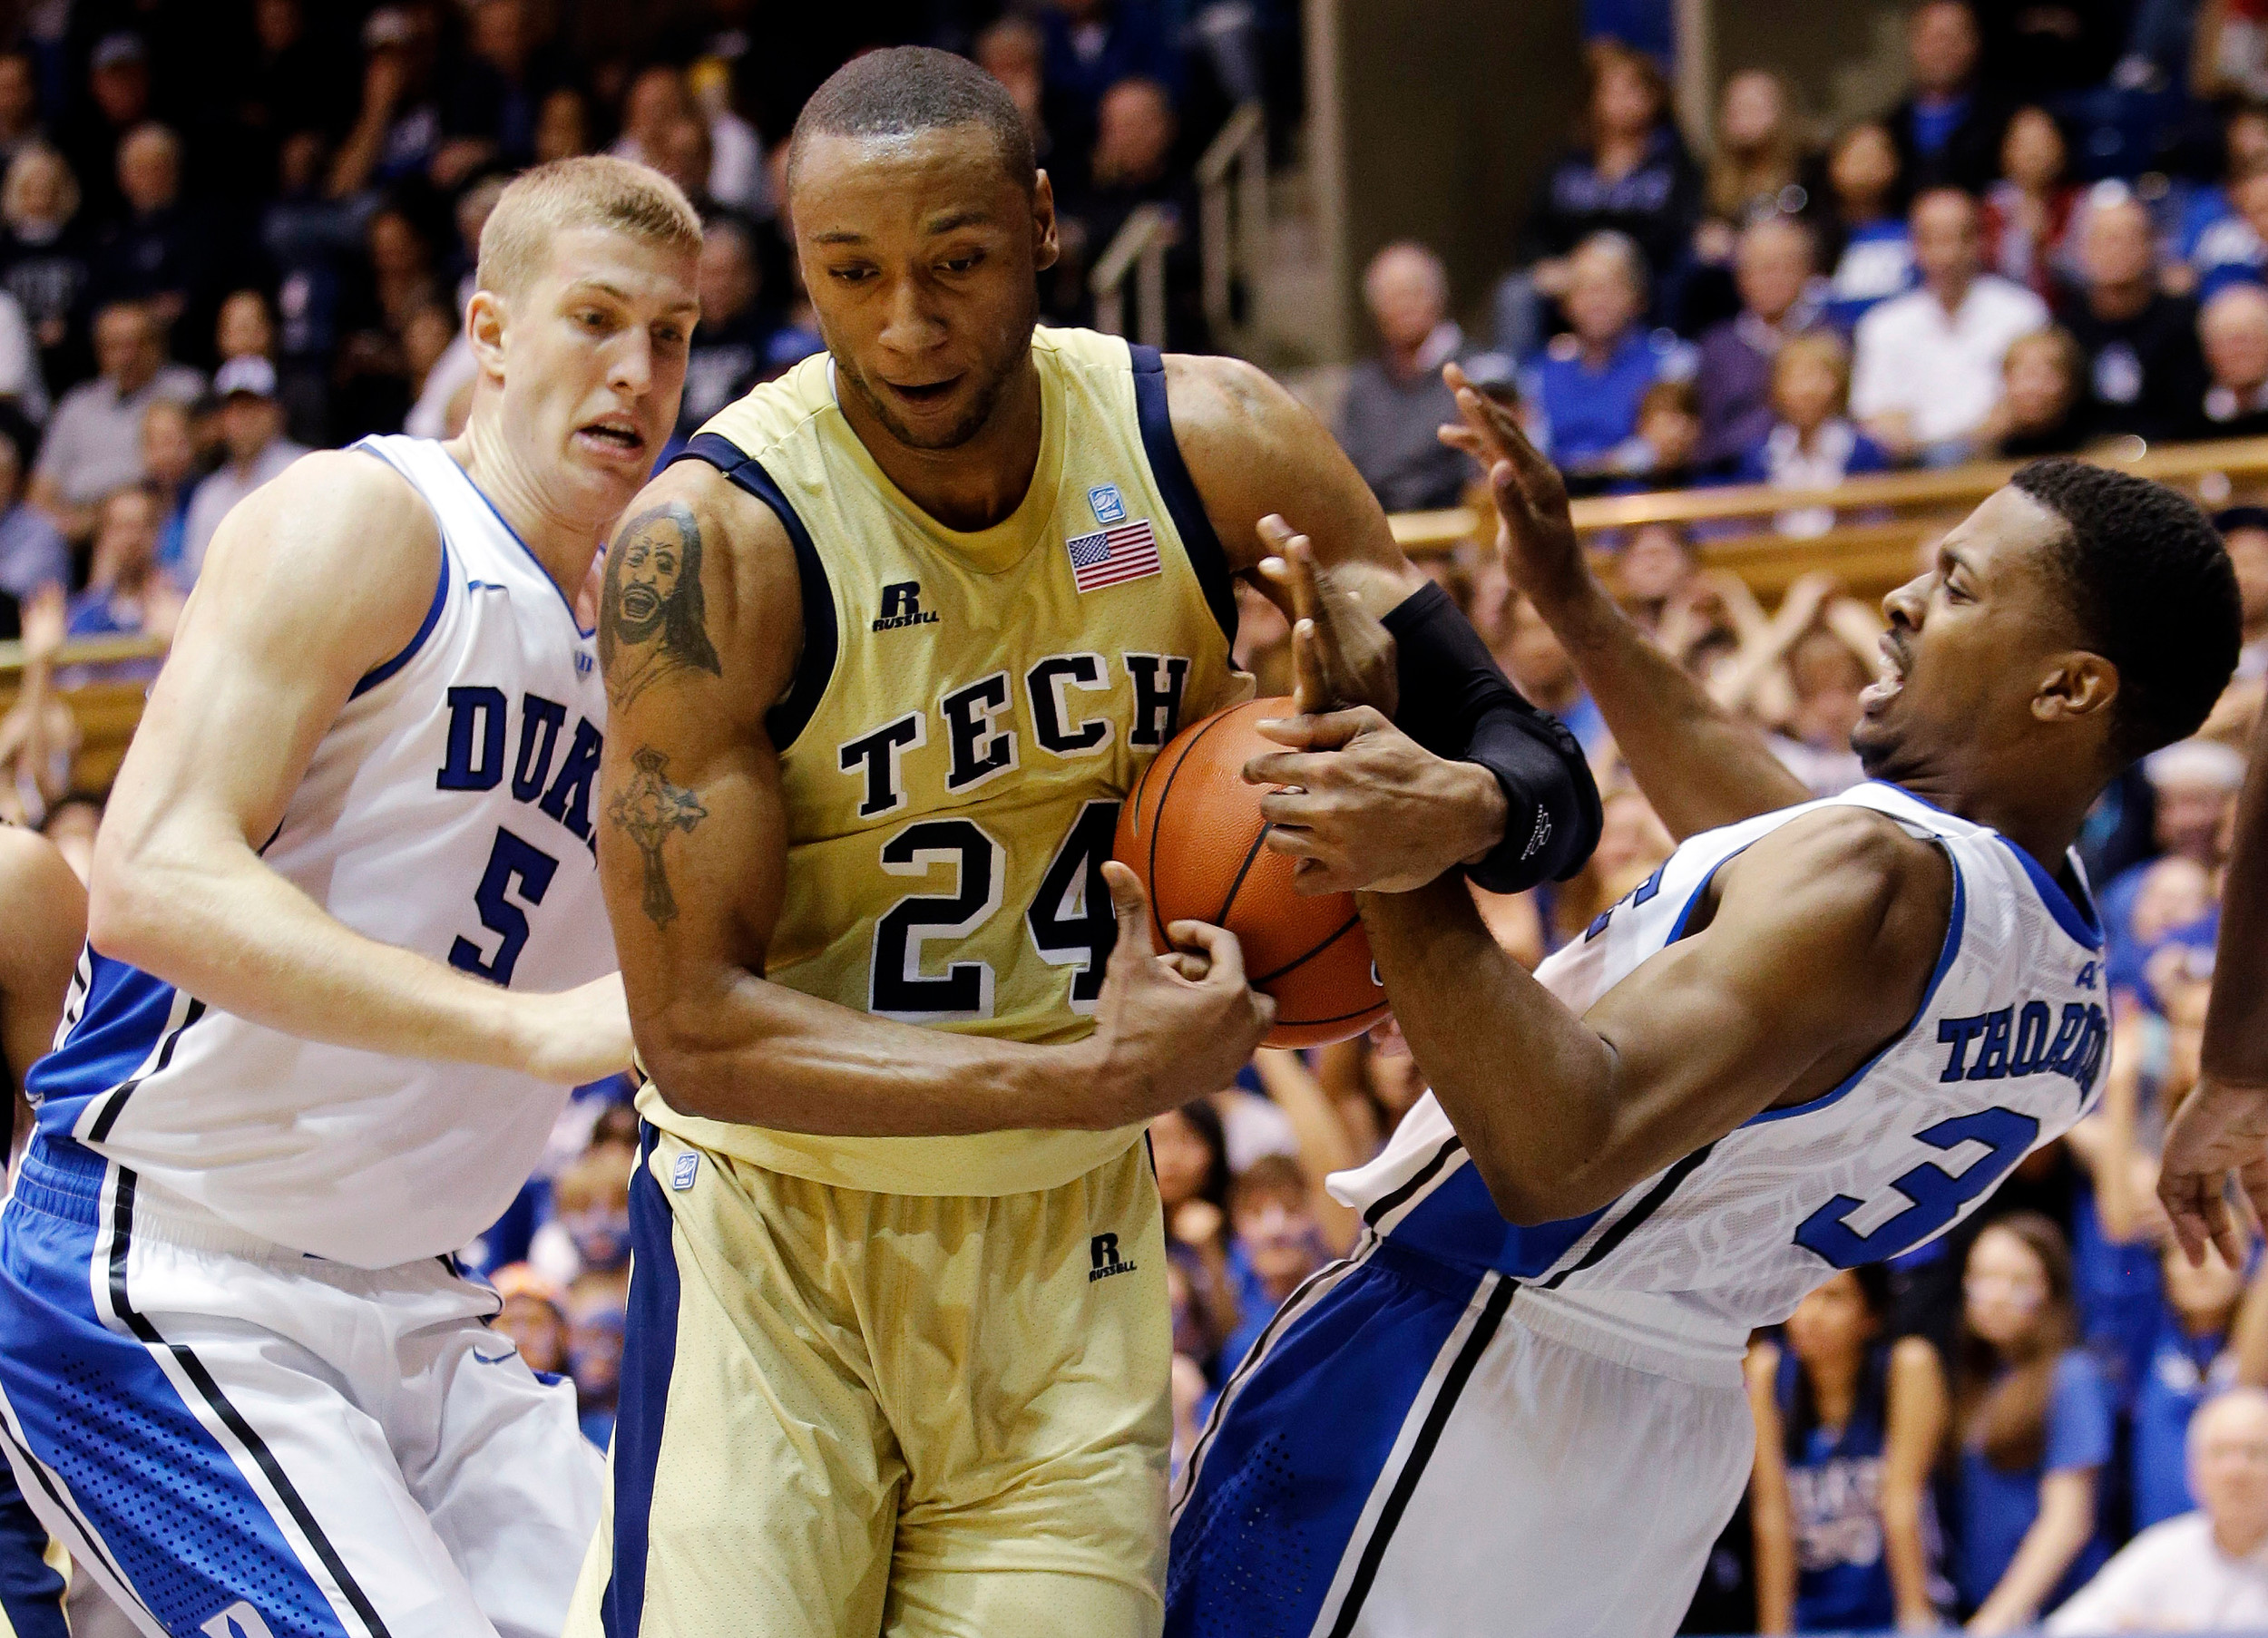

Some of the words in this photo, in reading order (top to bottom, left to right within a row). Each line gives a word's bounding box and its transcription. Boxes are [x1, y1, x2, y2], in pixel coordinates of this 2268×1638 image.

[873, 610, 939, 632] RUSSELL
[881, 581, 920, 619] R
[436, 687, 604, 872] DUK
[838, 650, 1190, 820] TECH
[448, 825, 560, 989] 5
[868, 799, 1127, 1023] 24
[1090, 1233, 1119, 1269] R
[1791, 1106, 2040, 1270] 3
[1089, 1261, 1138, 1282] RUSSELL
